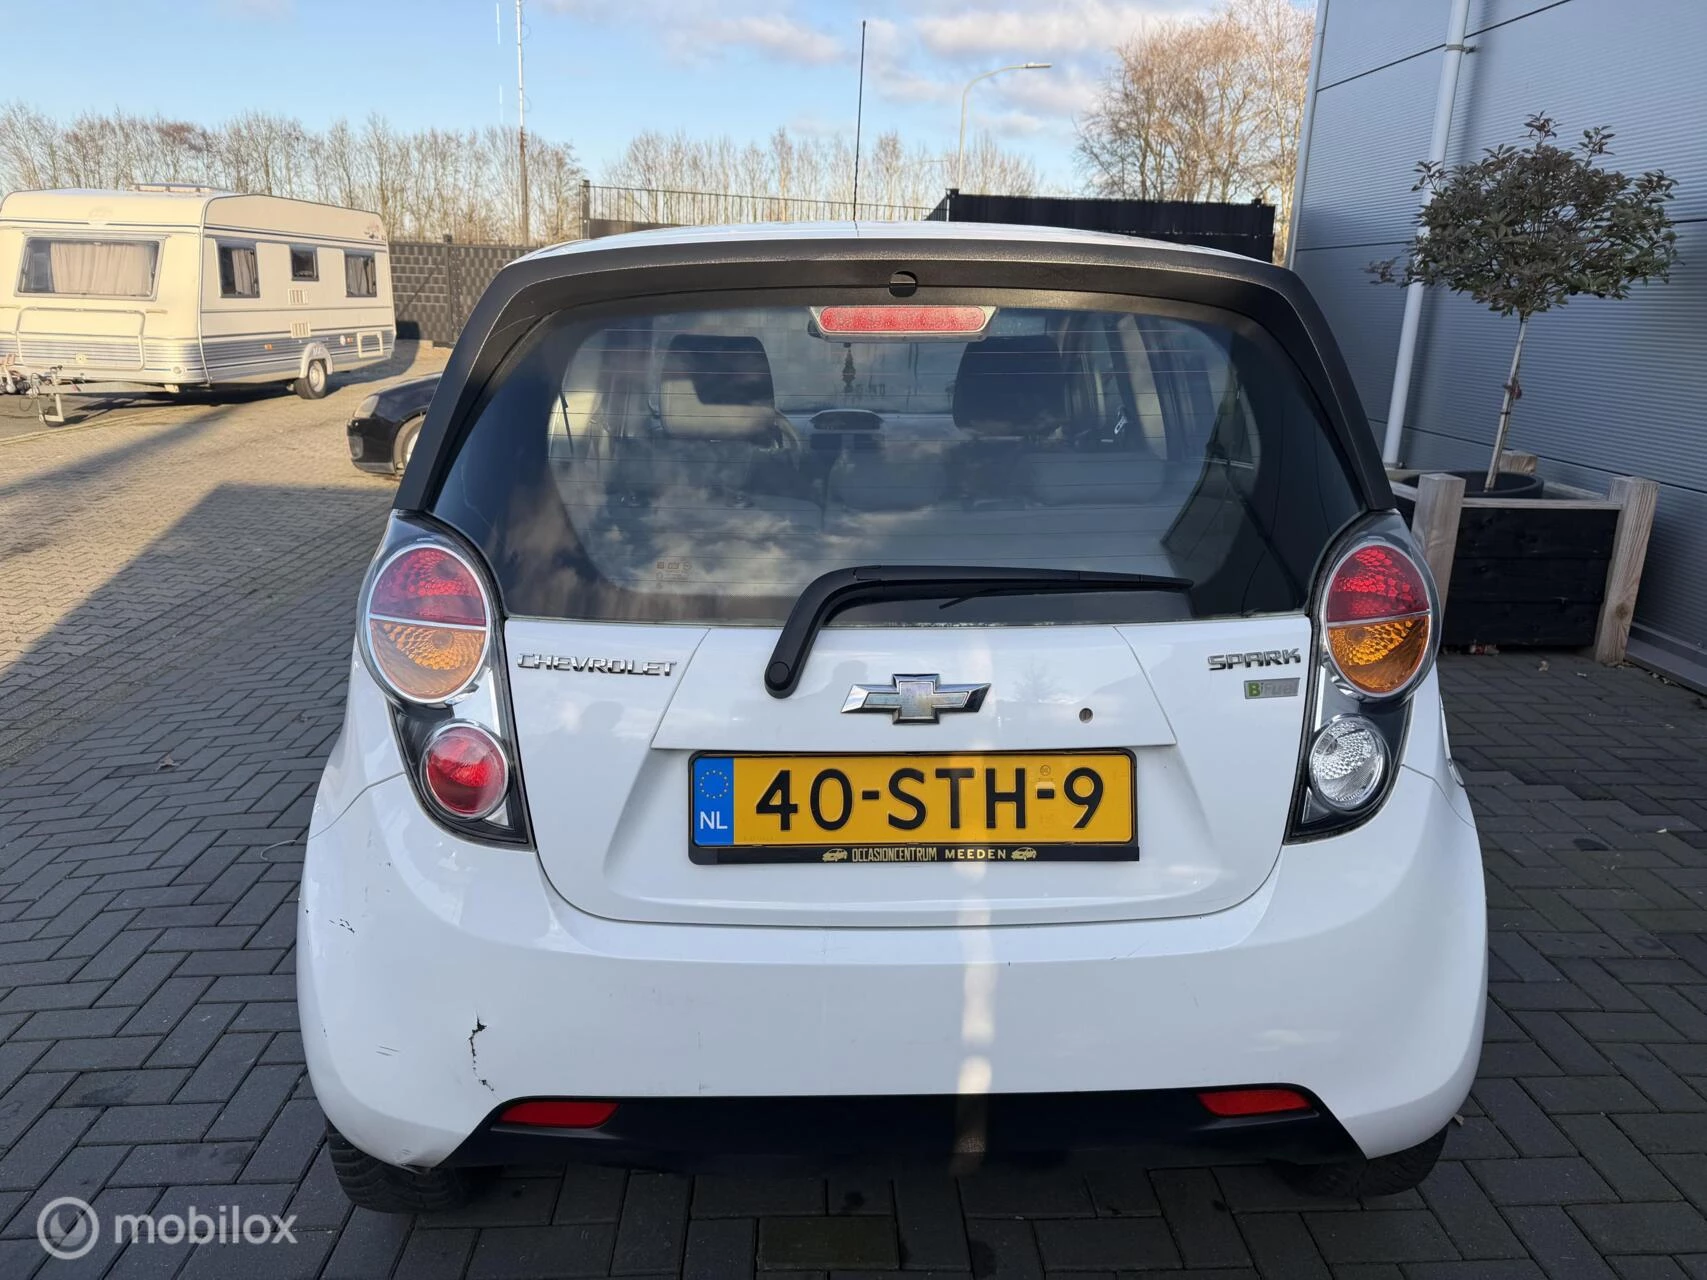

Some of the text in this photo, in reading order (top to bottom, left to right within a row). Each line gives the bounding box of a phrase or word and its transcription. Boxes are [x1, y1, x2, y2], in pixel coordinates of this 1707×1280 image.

[517, 654, 677, 676] CHEVROLET
[1208, 648, 1301, 671] SPARK
[756, 767, 1104, 831] 40-STH-9
[700, 811, 728, 829] NL
[852, 848, 1006, 862] OCCASIONCENTRUM MEEDEN
